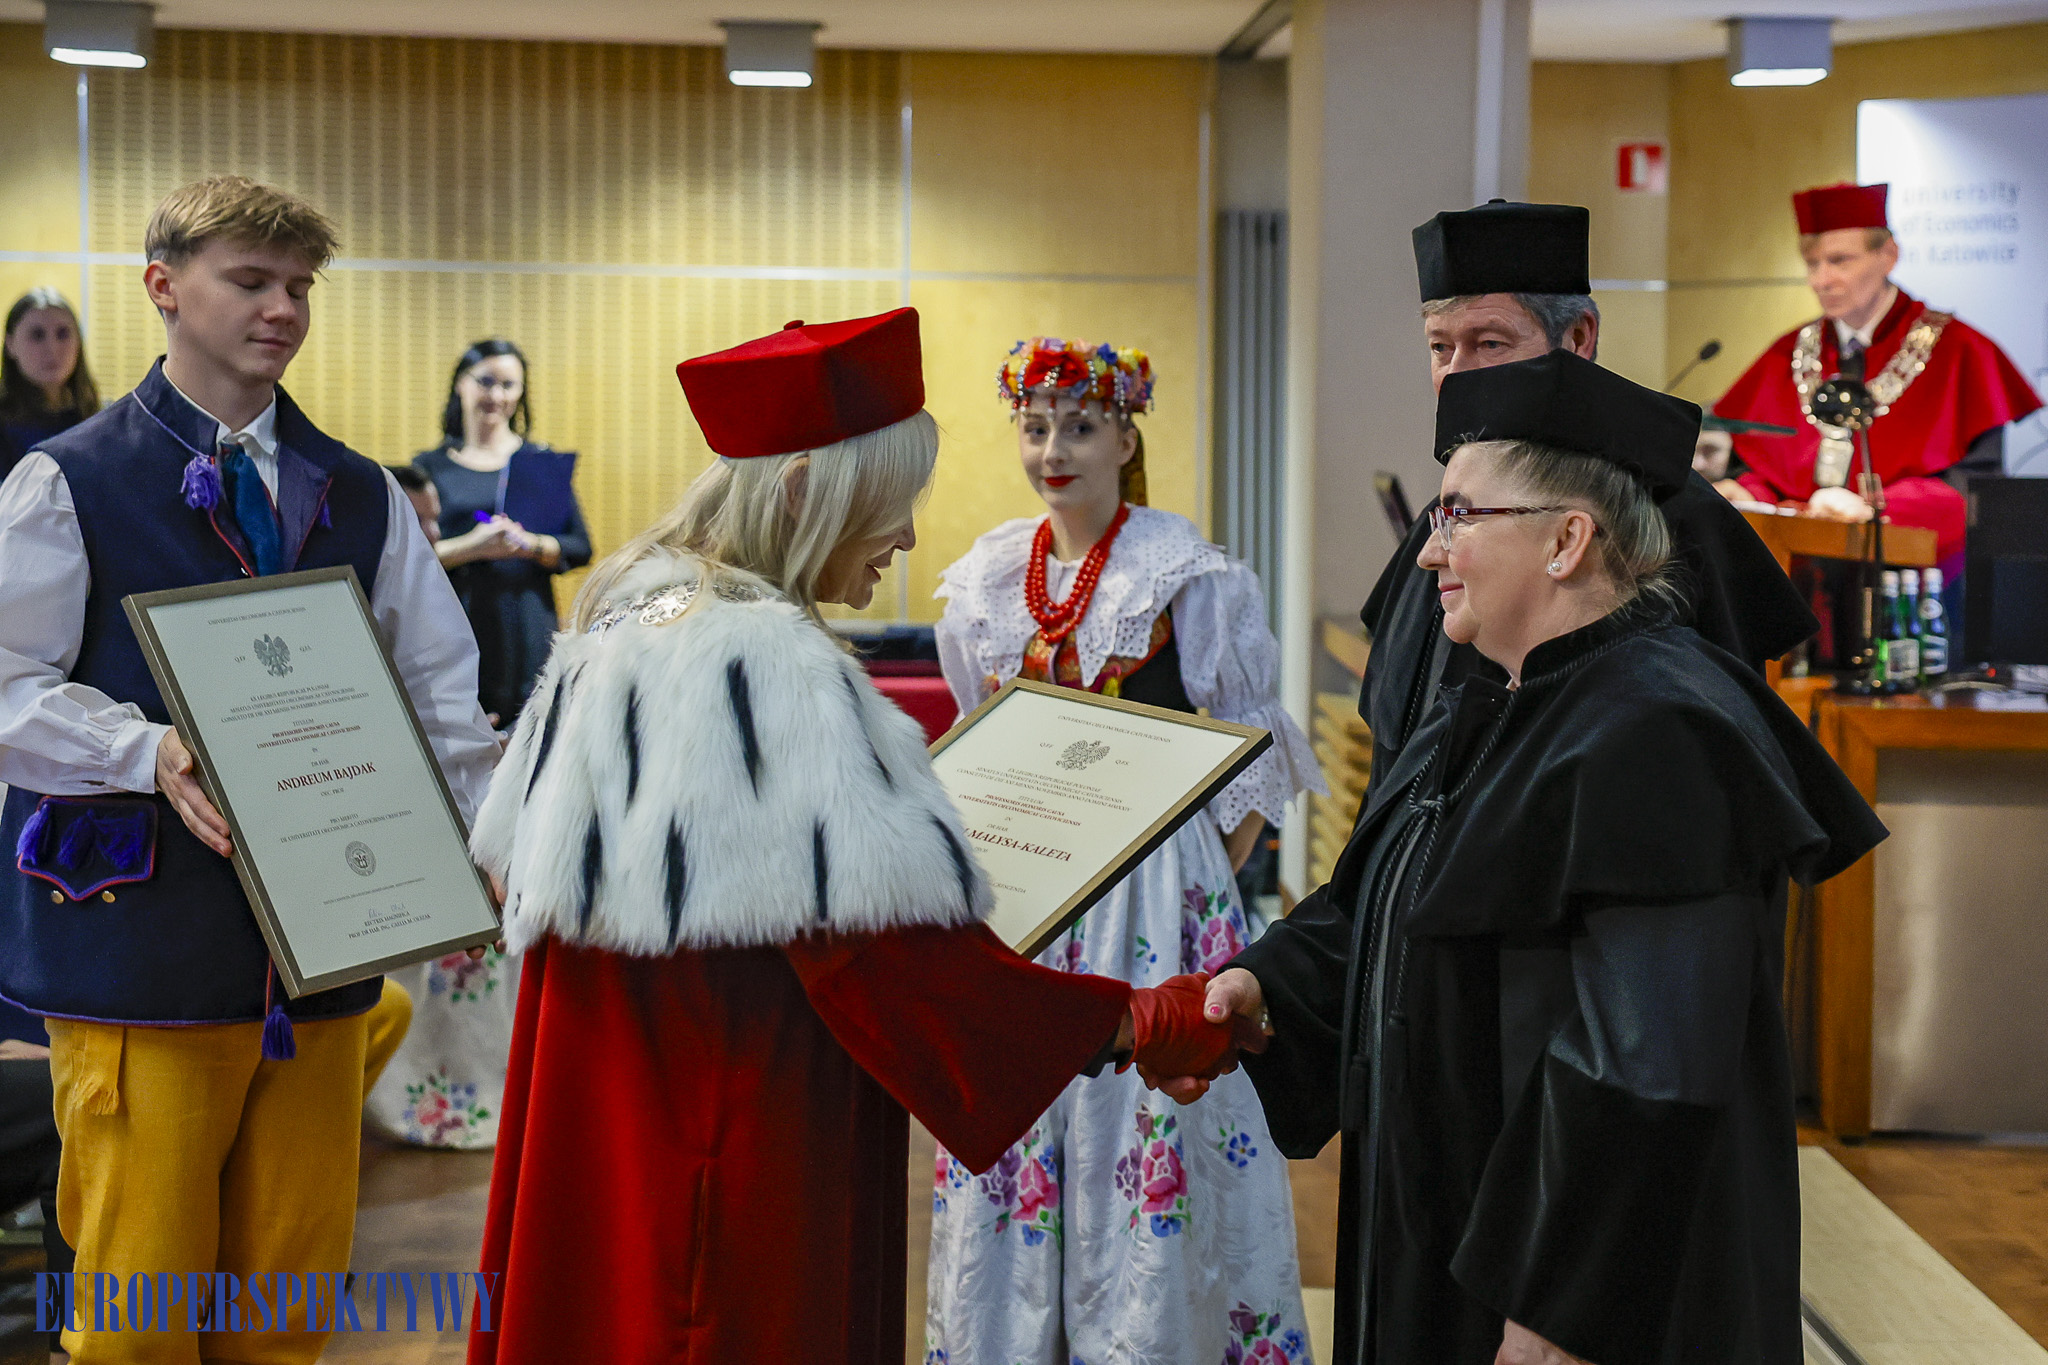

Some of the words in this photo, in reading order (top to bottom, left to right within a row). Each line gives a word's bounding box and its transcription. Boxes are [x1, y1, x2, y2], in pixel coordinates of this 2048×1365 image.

[277, 771, 333, 792] ANDREUM
[333, 762, 376, 780] BAJDAK
[968, 830, 1071, 861] MAŁYSA-KALETA
